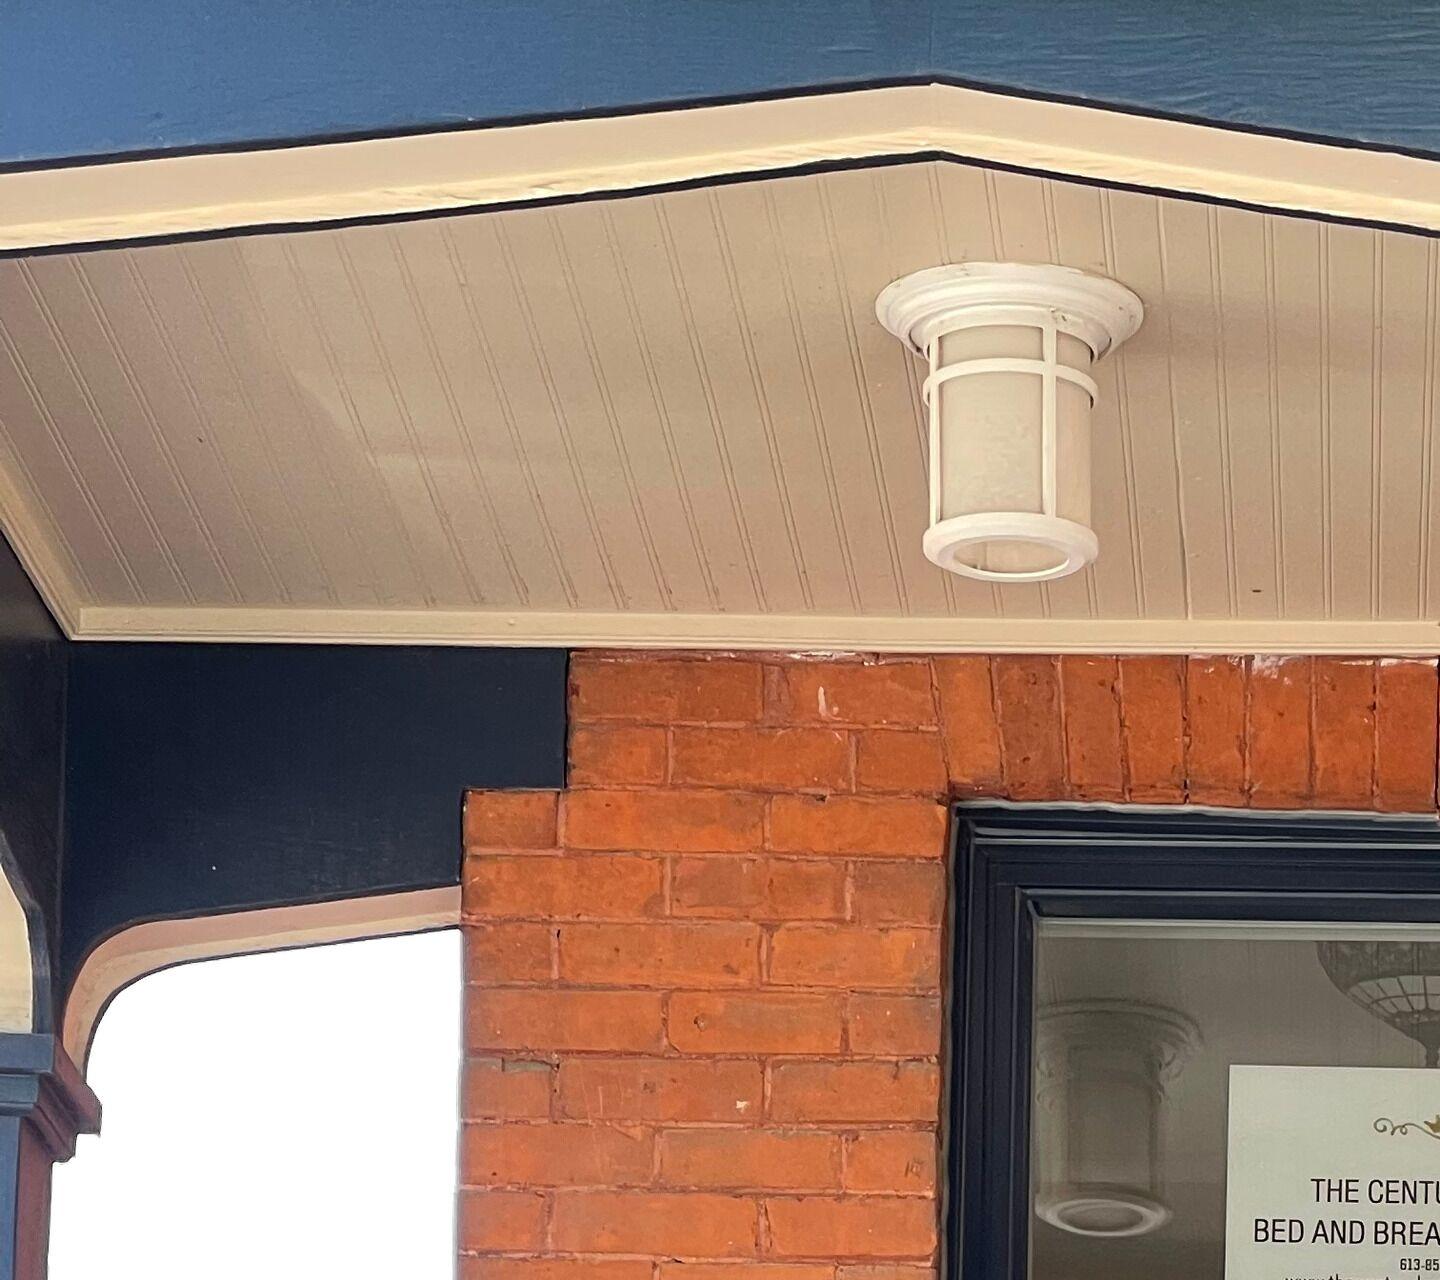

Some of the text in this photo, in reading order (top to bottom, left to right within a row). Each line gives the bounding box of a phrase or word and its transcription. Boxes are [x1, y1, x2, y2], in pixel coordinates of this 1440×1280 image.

[1311, 1178, 1359, 1204] THE
[1253, 1219, 1304, 1243] BED
[1311, 1220, 1366, 1245] AND
